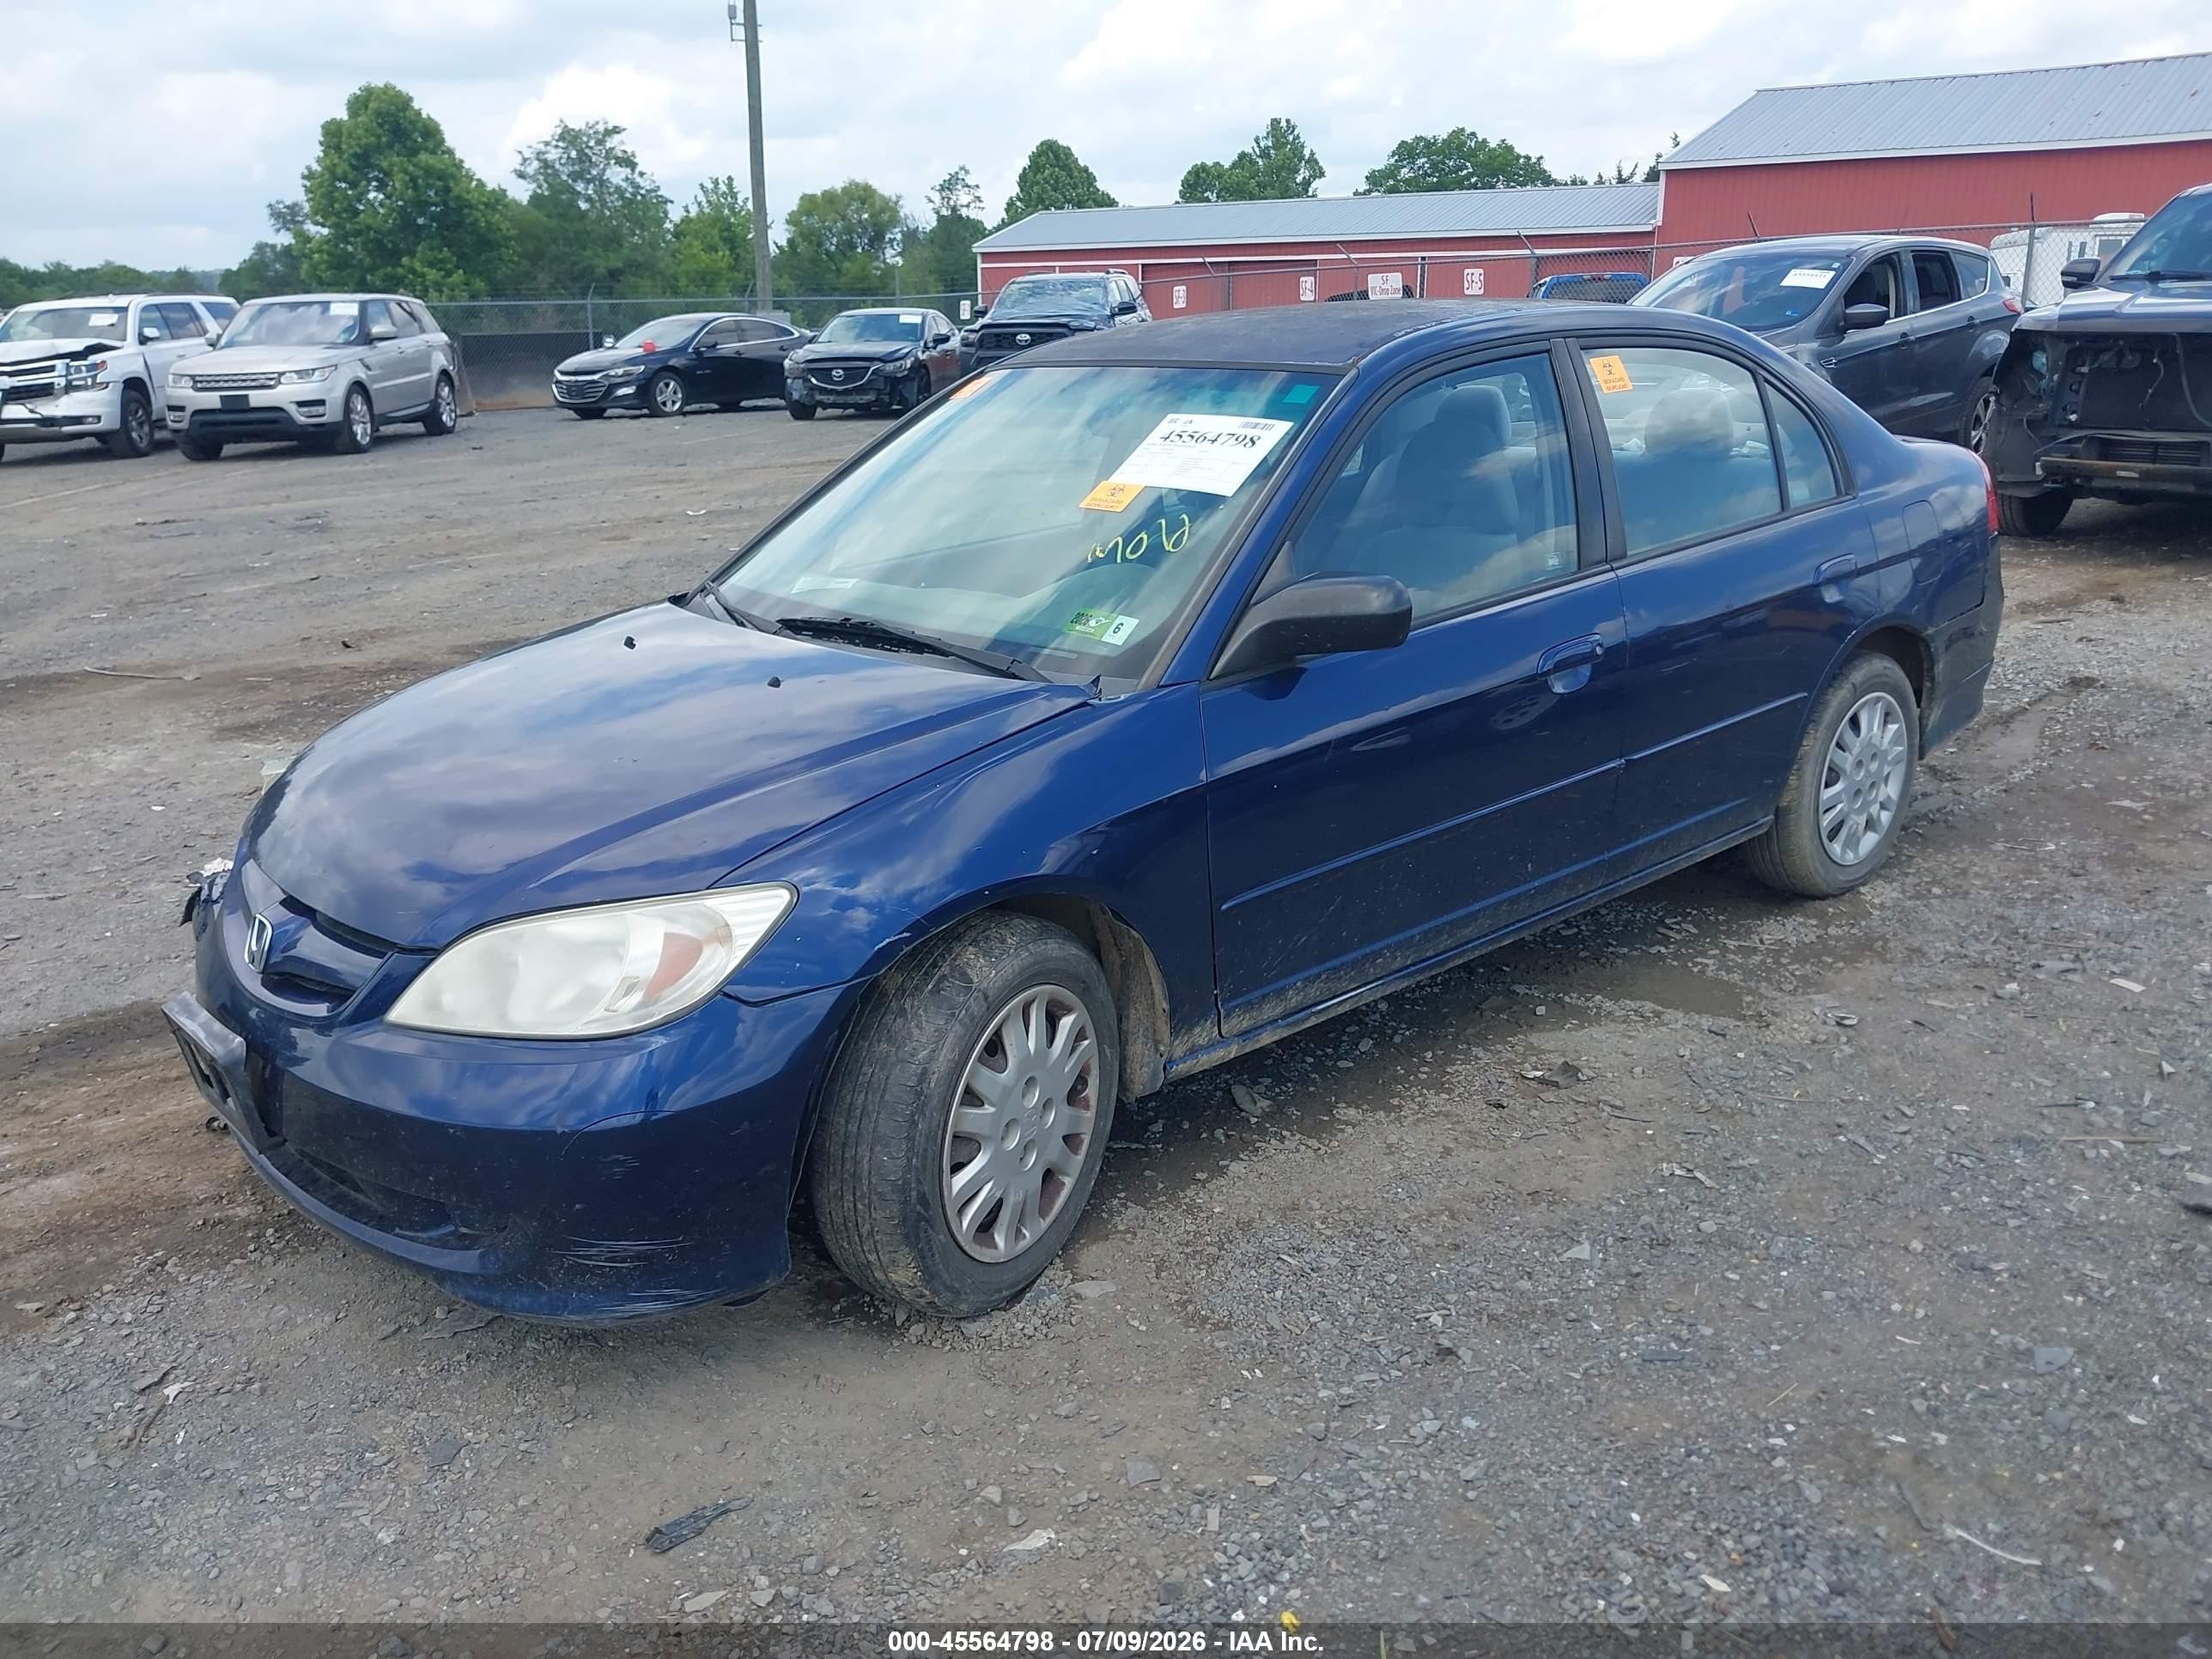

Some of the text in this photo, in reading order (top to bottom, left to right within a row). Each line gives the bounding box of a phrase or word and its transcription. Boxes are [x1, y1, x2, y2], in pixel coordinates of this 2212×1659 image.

[1301, 280, 1314, 297] SF-4
[1381, 275, 1389, 286] SF
[1465, 272, 1483, 291] SF-5
[1174, 289, 1186, 305] SF-3
[1390, 285, 1401, 295] Zone
[1160, 429, 1261, 449] 45564798
[1112, 622, 1125, 635] 6
